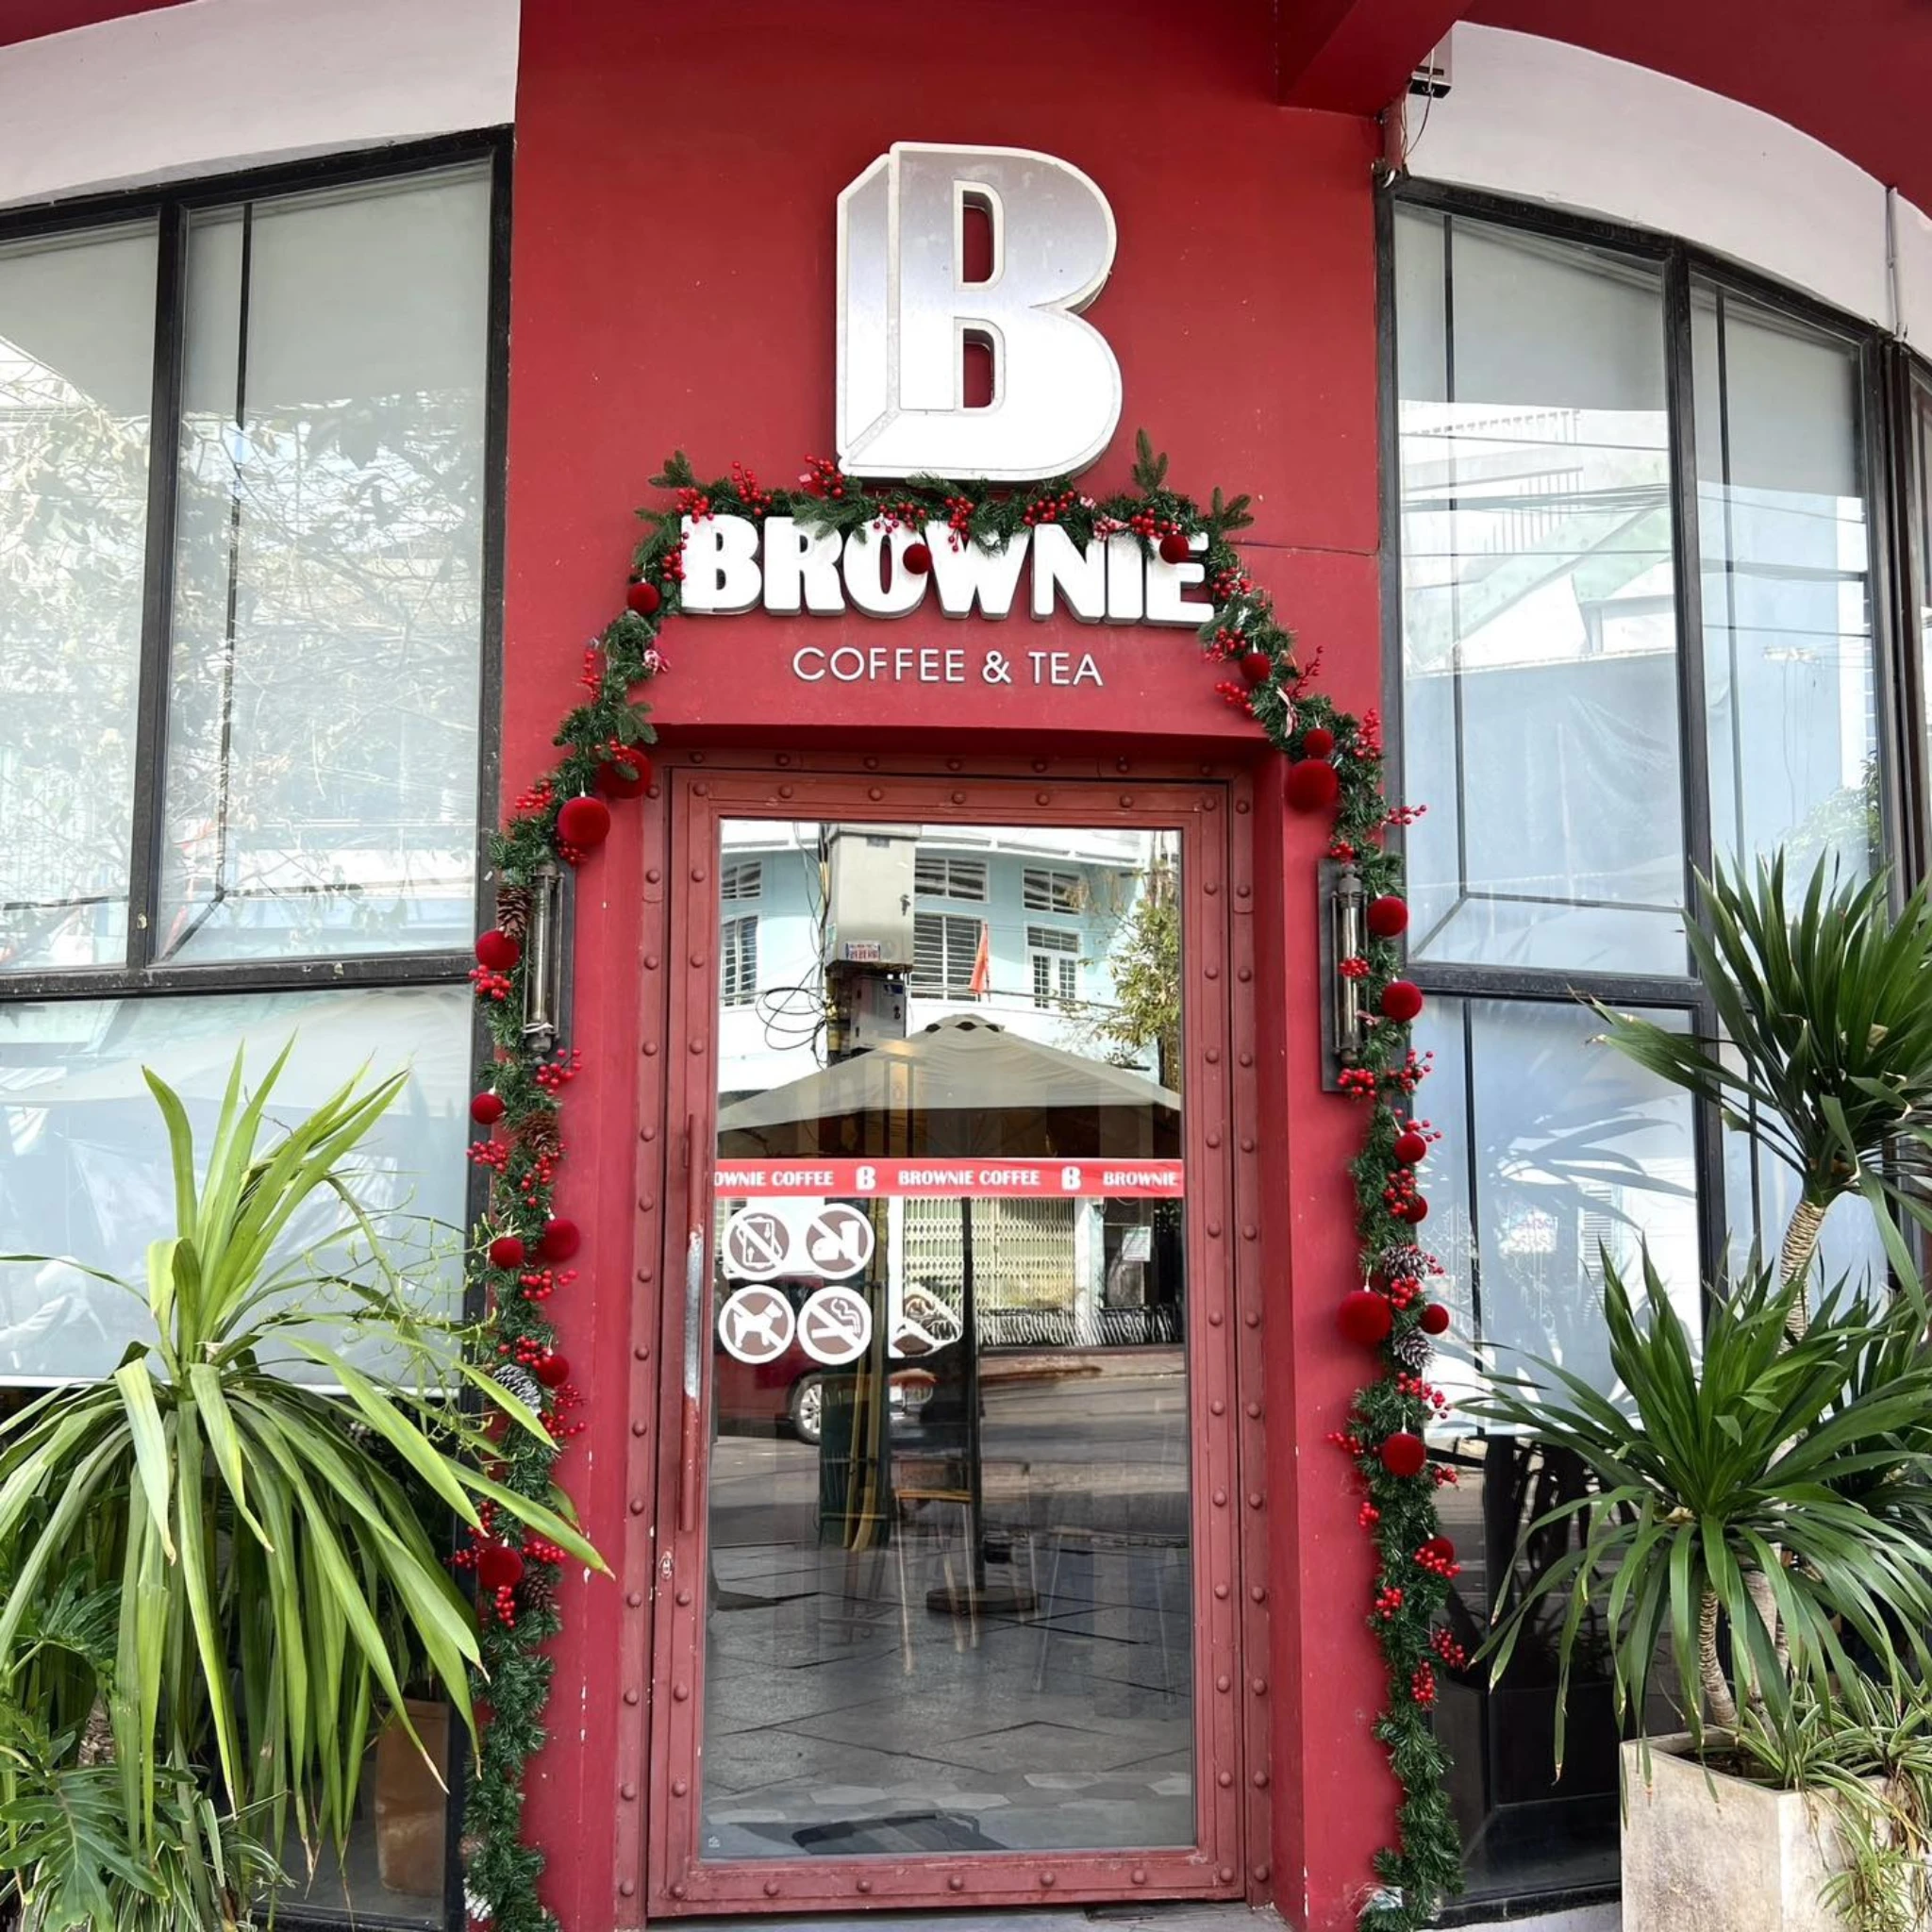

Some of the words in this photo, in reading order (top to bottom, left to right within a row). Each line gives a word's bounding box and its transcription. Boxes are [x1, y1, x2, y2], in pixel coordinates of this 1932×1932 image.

[836, 142, 1123, 481] B
[681, 514, 1214, 626] BROWNIE
[792, 646, 965, 682] COFFEE
[981, 650, 1012, 685] &
[1028, 651, 1104, 687] TEA
[772, 1170, 834, 1187] COFFEE
[856, 1165, 876, 1191] B
[898, 1170, 974, 1186] BROWNIE
[978, 1170, 1041, 1186] COFFEE
[1061, 1166, 1082, 1191] B
[1103, 1171, 1178, 1187] BROWNIE
